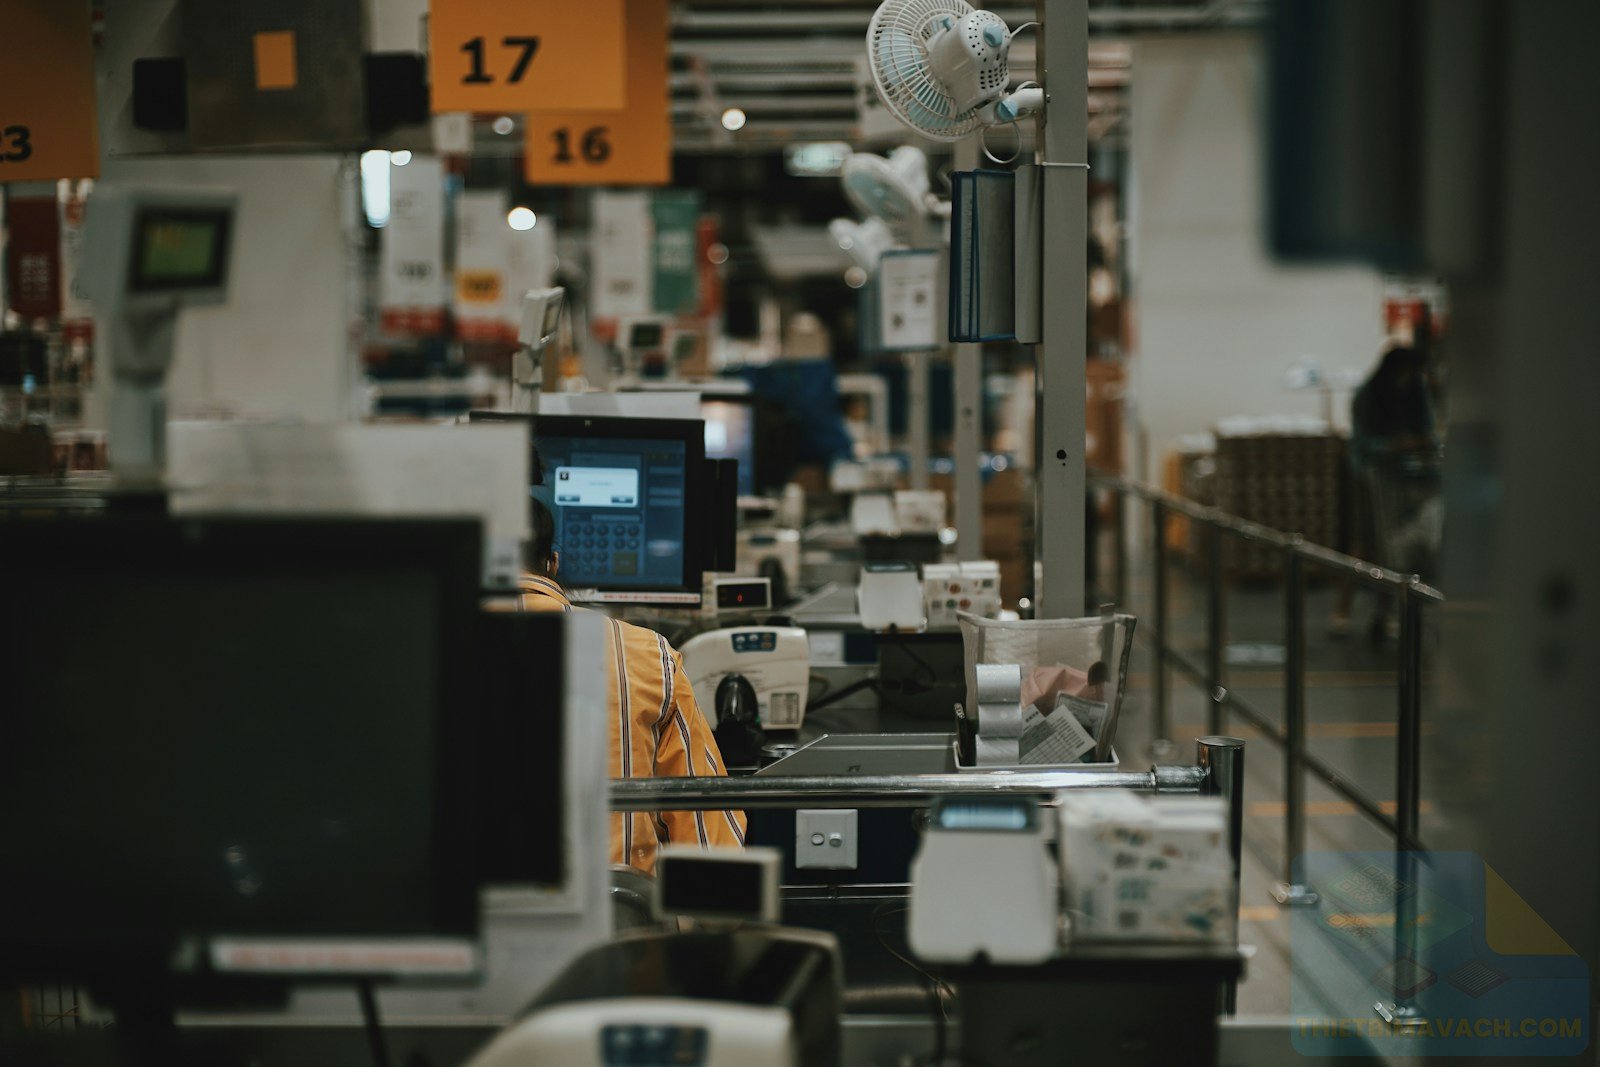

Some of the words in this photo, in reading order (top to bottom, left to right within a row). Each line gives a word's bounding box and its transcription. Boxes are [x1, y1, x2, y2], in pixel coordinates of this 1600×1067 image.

[461, 36, 540, 84] 17
[0, 125, 32, 163] 3
[552, 126, 612, 164] 16
